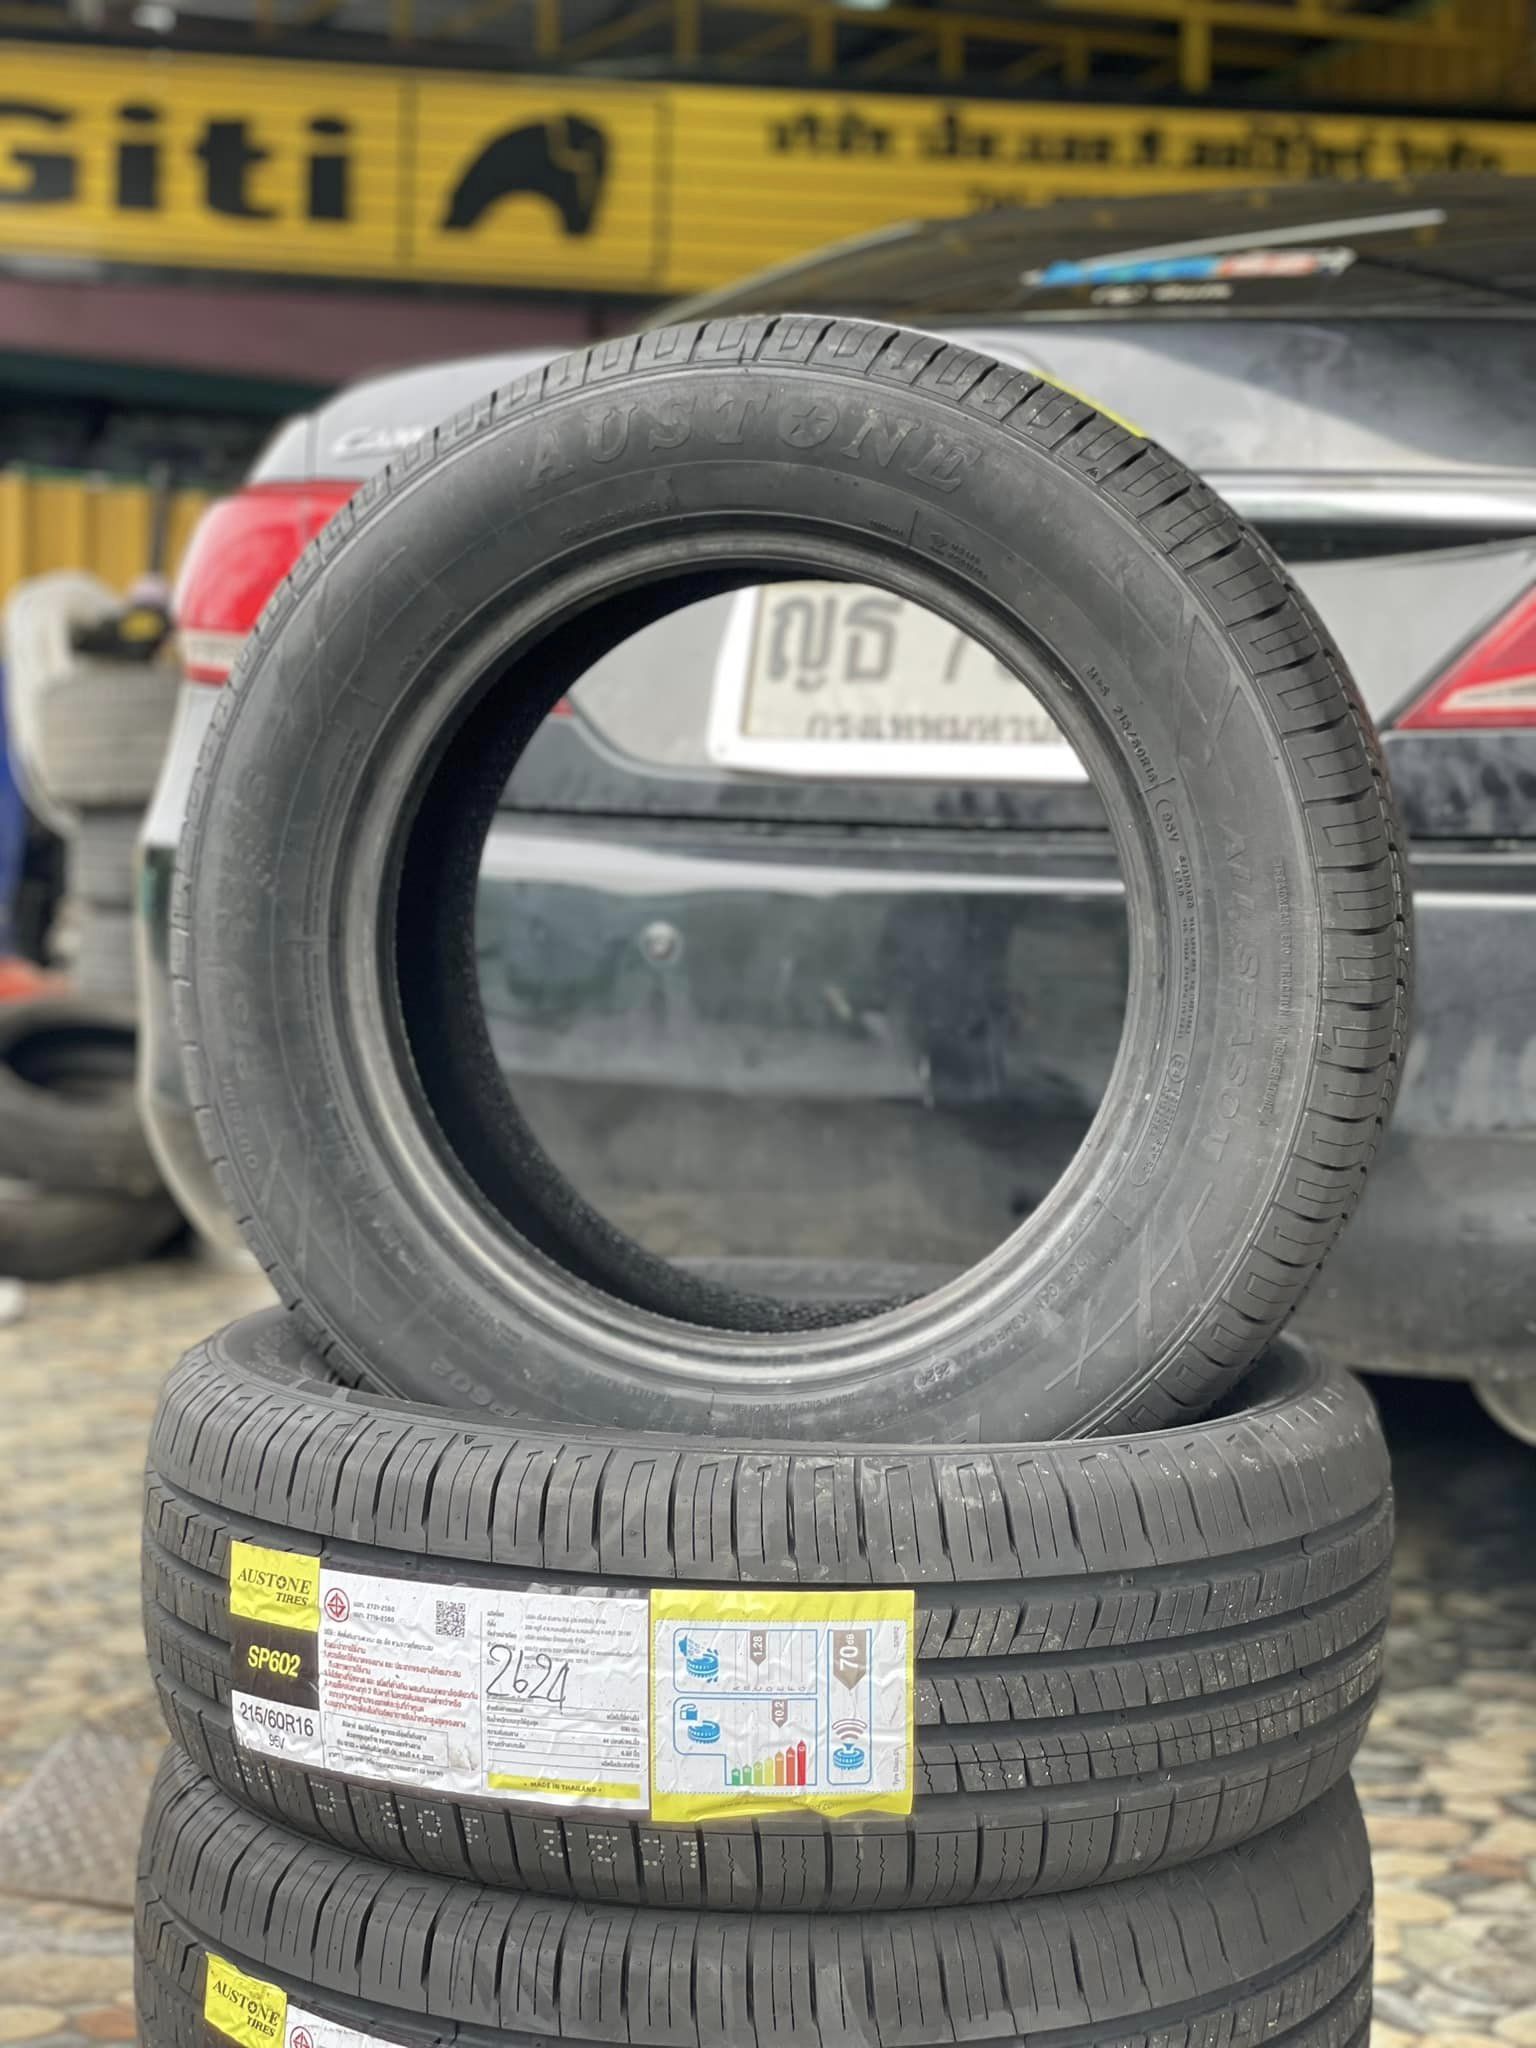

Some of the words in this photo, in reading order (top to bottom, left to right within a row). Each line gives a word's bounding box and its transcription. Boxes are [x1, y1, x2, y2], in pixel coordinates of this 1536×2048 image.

[0, 103, 352, 222] Giti
[524, 392, 984, 495] AUSTONE
[237, 1567, 312, 1595] AUSTONE
[275, 1591, 309, 1607] TIRES
[752, 1635, 763, 1657] 1.28
[839, 1644, 860, 1671] 70
[248, 1645, 301, 1678] SP602
[239, 1702, 314, 1737] 215/60R16
[774, 1700, 786, 1722] 10.2
[530, 1781, 551, 1790] MADE
[552, 1783, 560, 1791] IN
[561, 1784, 598, 1793] THAILAND
[212, 1979, 281, 2027] AUSTONE
[246, 2015, 276, 2037] TIRES
